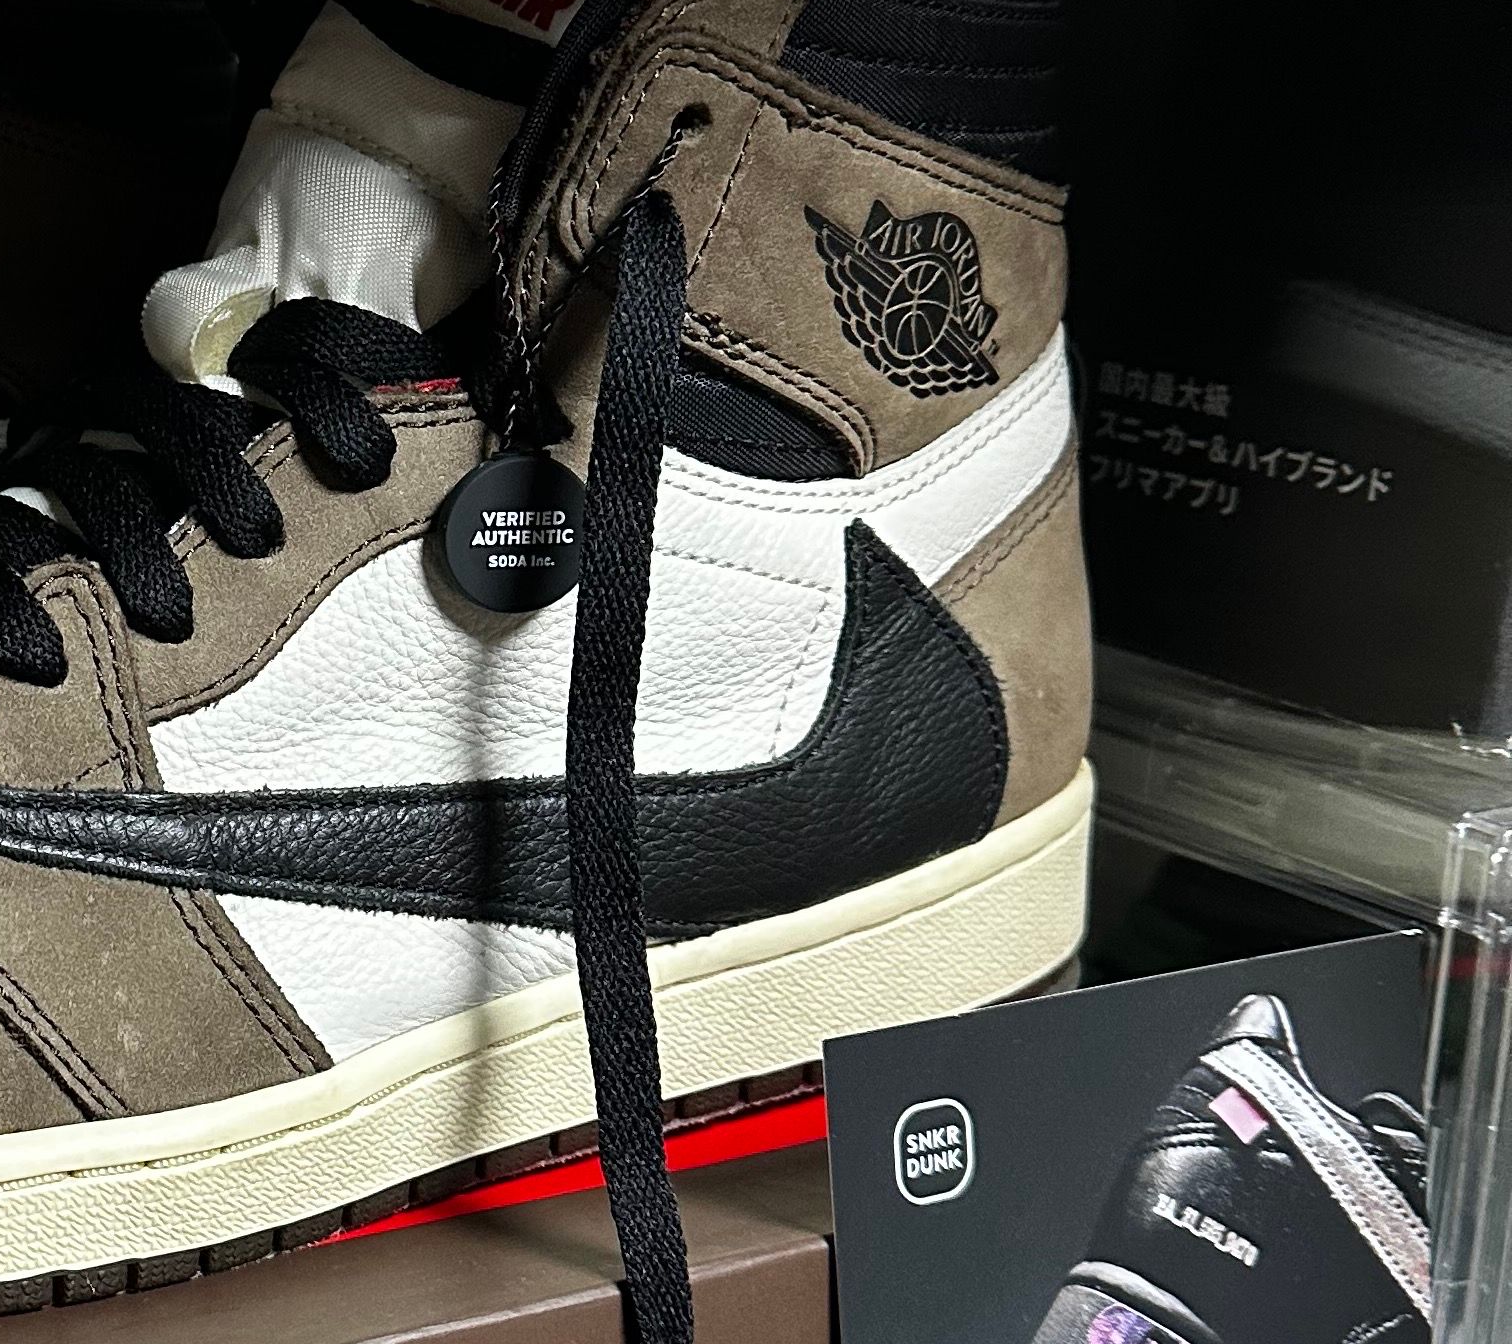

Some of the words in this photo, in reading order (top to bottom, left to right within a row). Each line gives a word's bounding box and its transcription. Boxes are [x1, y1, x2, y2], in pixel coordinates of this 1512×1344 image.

[869, 217, 923, 256] AIR
[930, 216, 986, 338] JORDAN
[482, 511, 565, 527] VERIFIED
[471, 529, 574, 547] AUTHENTIC
[488, 555, 527, 568] SODA
[906, 1124, 963, 1154] SNKR
[906, 1147, 965, 1179] DUNK
